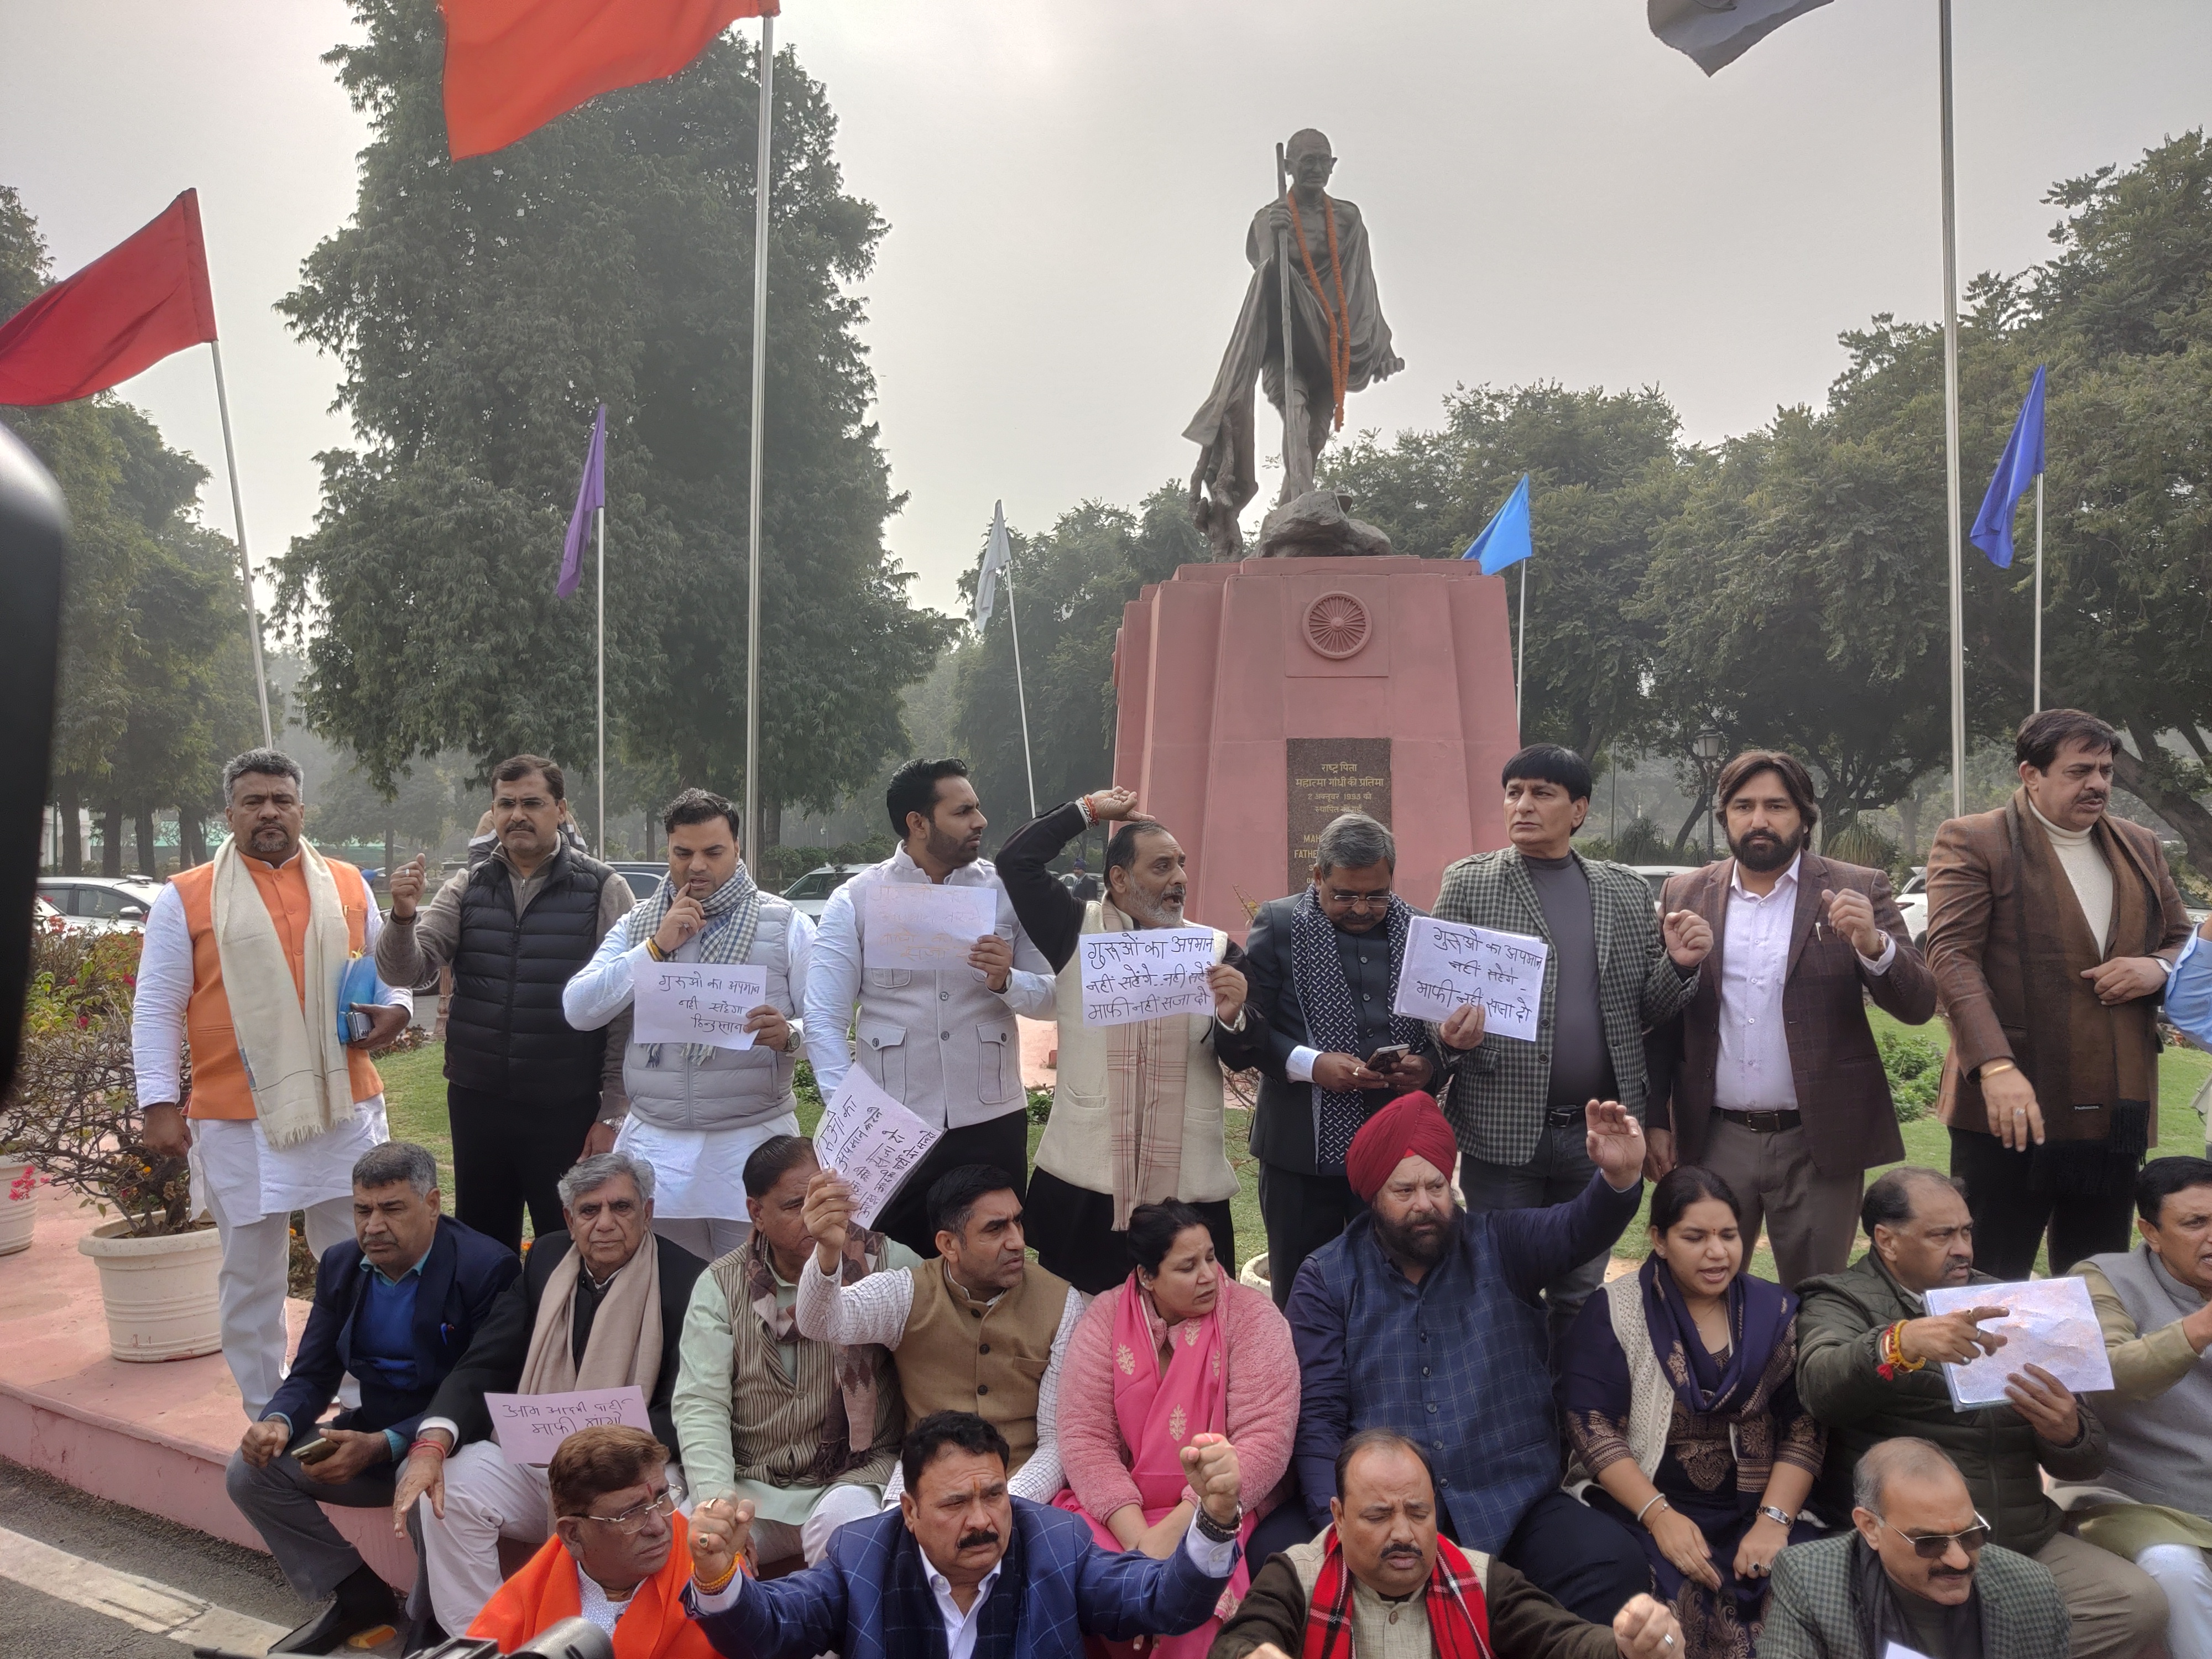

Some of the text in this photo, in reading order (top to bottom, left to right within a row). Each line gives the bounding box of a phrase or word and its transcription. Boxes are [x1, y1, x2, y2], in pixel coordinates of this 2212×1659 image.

[1321, 761, 1357, 774] राष्ट्र पिता
[1296, 776, 1384, 787] महात्मा गांधी की प्रतिमा
[1363, 792, 1372, 800] को
[1145, 941, 1168, 959] का
[1171, 936, 1214, 953] अपमान
[1486, 943, 1501, 956] का
[1504, 945, 1543, 971] अपमान
[1086, 973, 1115, 993] नहीं
[1163, 963, 1187, 988] नहीं
[1448, 960, 1481, 977] नहीं
[707, 978, 722, 990] का
[728, 980, 760, 995] अपमान
[1131, 993, 1160, 1014] नहीं
[1161, 993, 1197, 1010] सजा
[1194, 986, 1211, 1006] दो
[1486, 998, 1515, 1018] सजा
[1516, 997, 1532, 1024] दो
[842, 1094, 857, 1118] का
[835, 1126, 869, 1173] अपमान
[503, 1405, 540, 1418] आम
